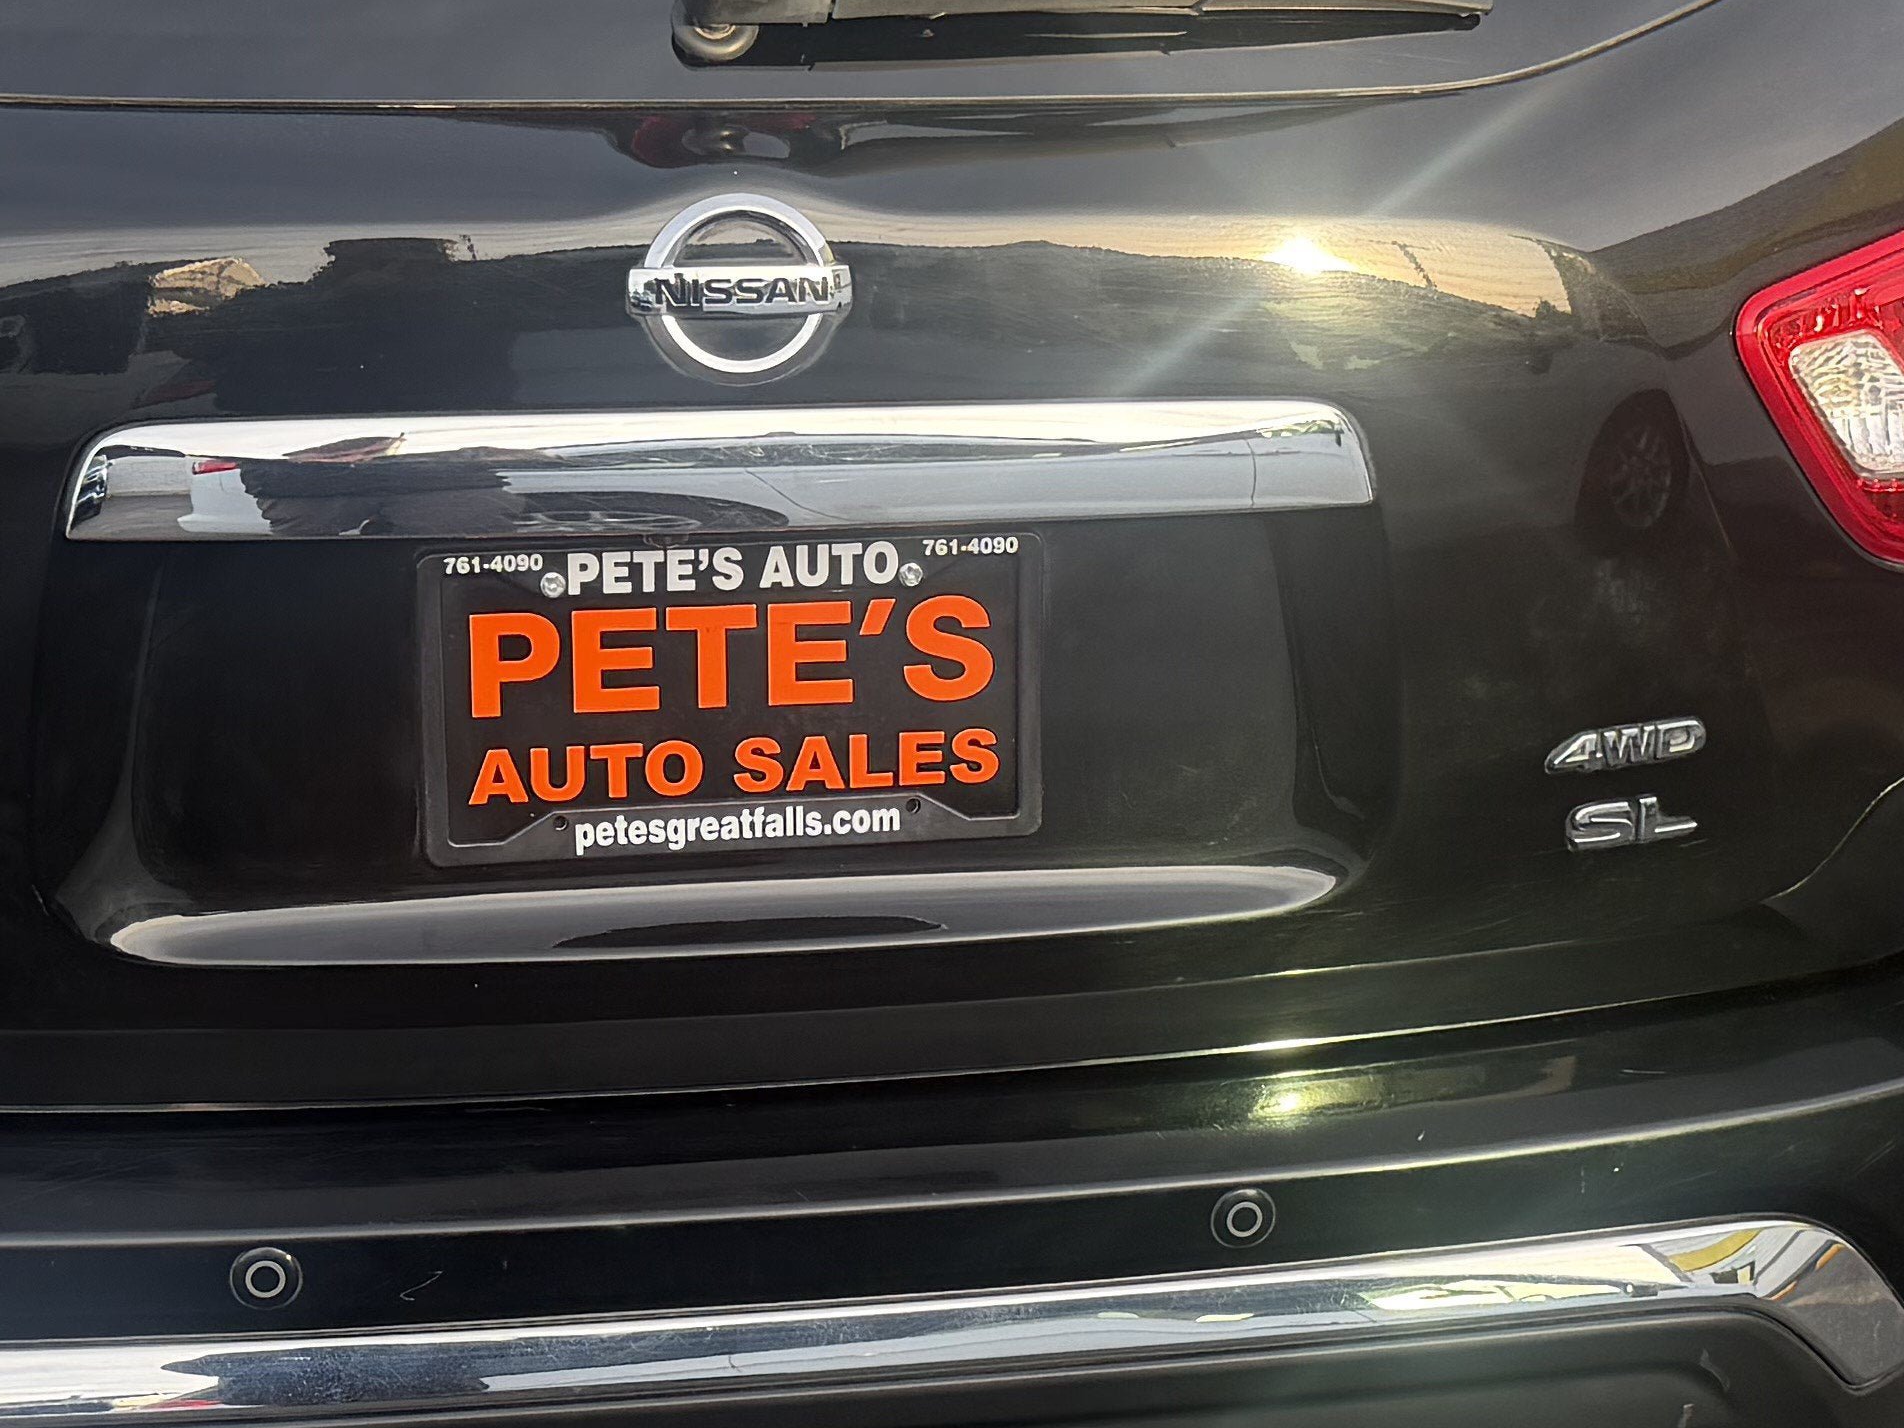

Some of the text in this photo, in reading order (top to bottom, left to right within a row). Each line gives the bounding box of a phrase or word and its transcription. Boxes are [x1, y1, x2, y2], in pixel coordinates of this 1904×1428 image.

[655, 275, 828, 305] NISSAN
[443, 554, 543, 576] 761-4090
[567, 540, 899, 596] PETE'S AUTO
[922, 536, 1019, 556] 761-4090
[468, 595, 995, 718] PETE'S
[468, 728, 1000, 806] AUTO SALES
[1545, 718, 1707, 774] 4WD
[575, 804, 901, 856] petesgreatfalls.com
[1566, 794, 1698, 852] SL
